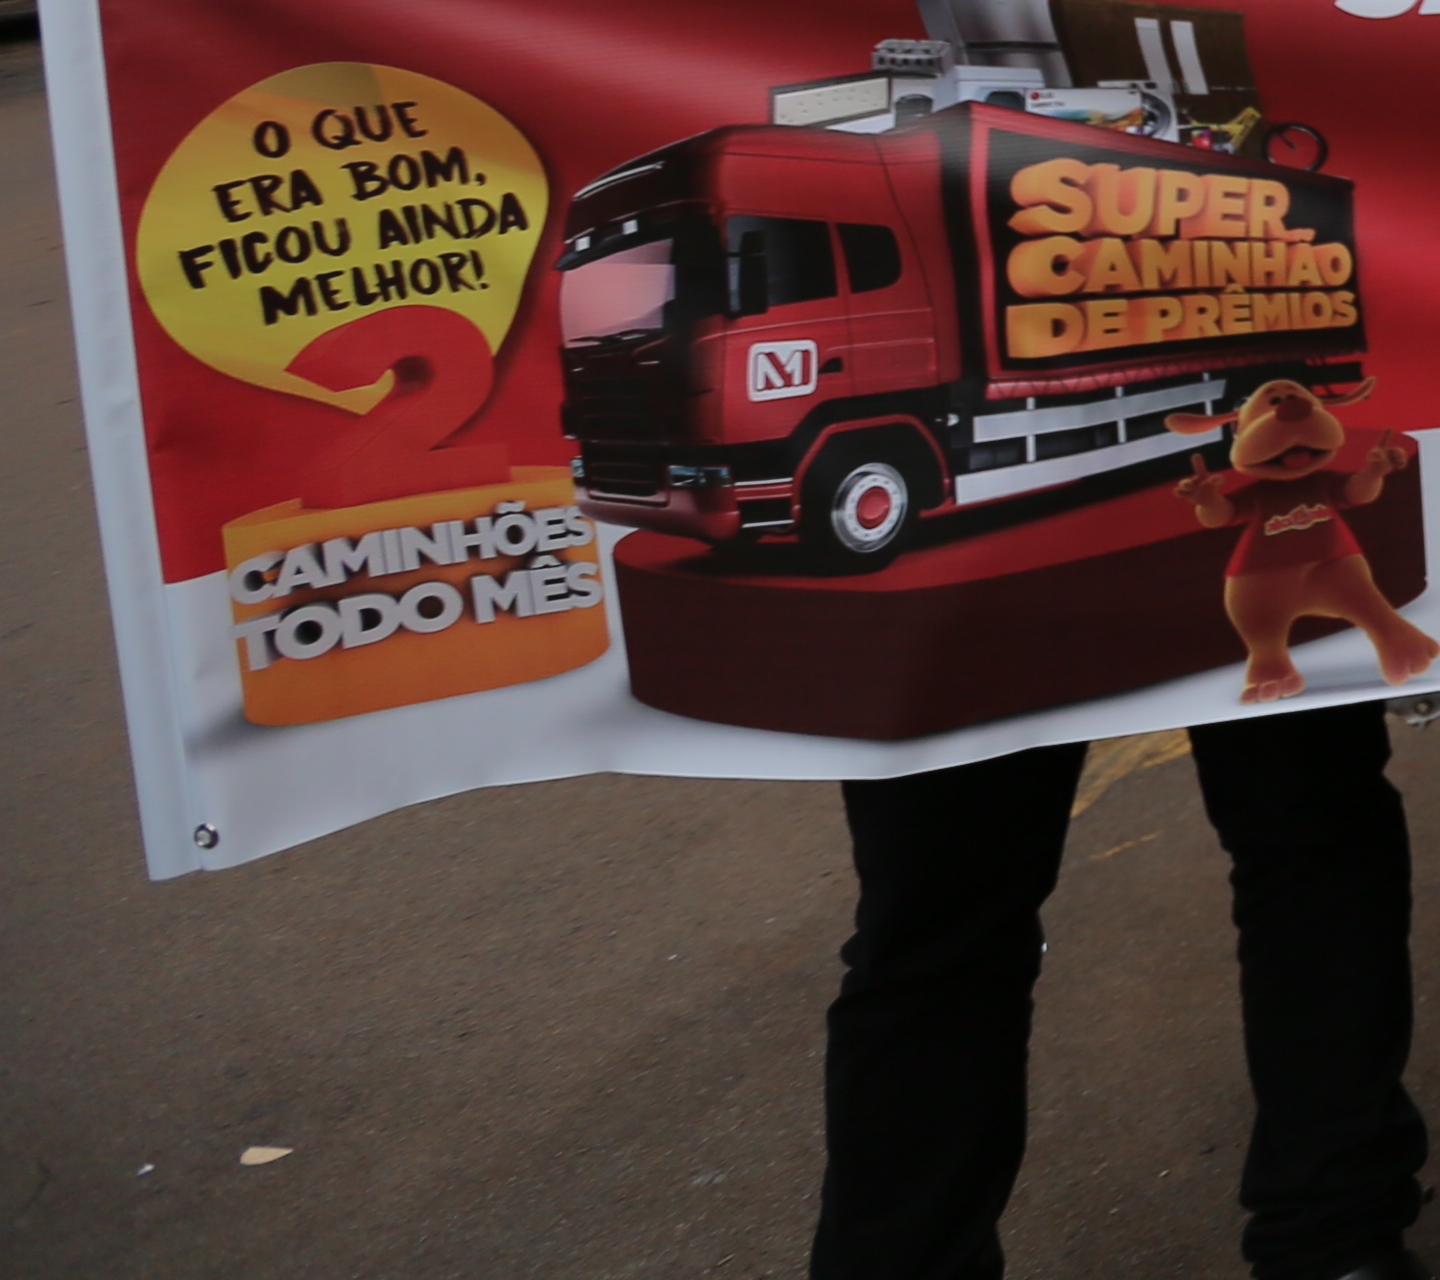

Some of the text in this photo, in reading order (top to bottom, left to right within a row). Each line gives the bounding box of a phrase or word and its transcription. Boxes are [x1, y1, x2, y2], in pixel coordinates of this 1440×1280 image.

[253, 100, 430, 159] O QUE
[211, 145, 488, 224] ERA BOM,
[1007, 157, 1310, 242] SUPER
[177, 191, 531, 291] FICOU AINDA
[1006, 230, 1354, 298] CAMINHÃO
[257, 248, 491, 327] MELHOR!
[1005, 285, 1358, 359] DE PRÊMIOS
[284, 303, 512, 511] 2
[230, 500, 595, 606] CAMINHÕES
[234, 554, 603, 673] TODO MÊS
